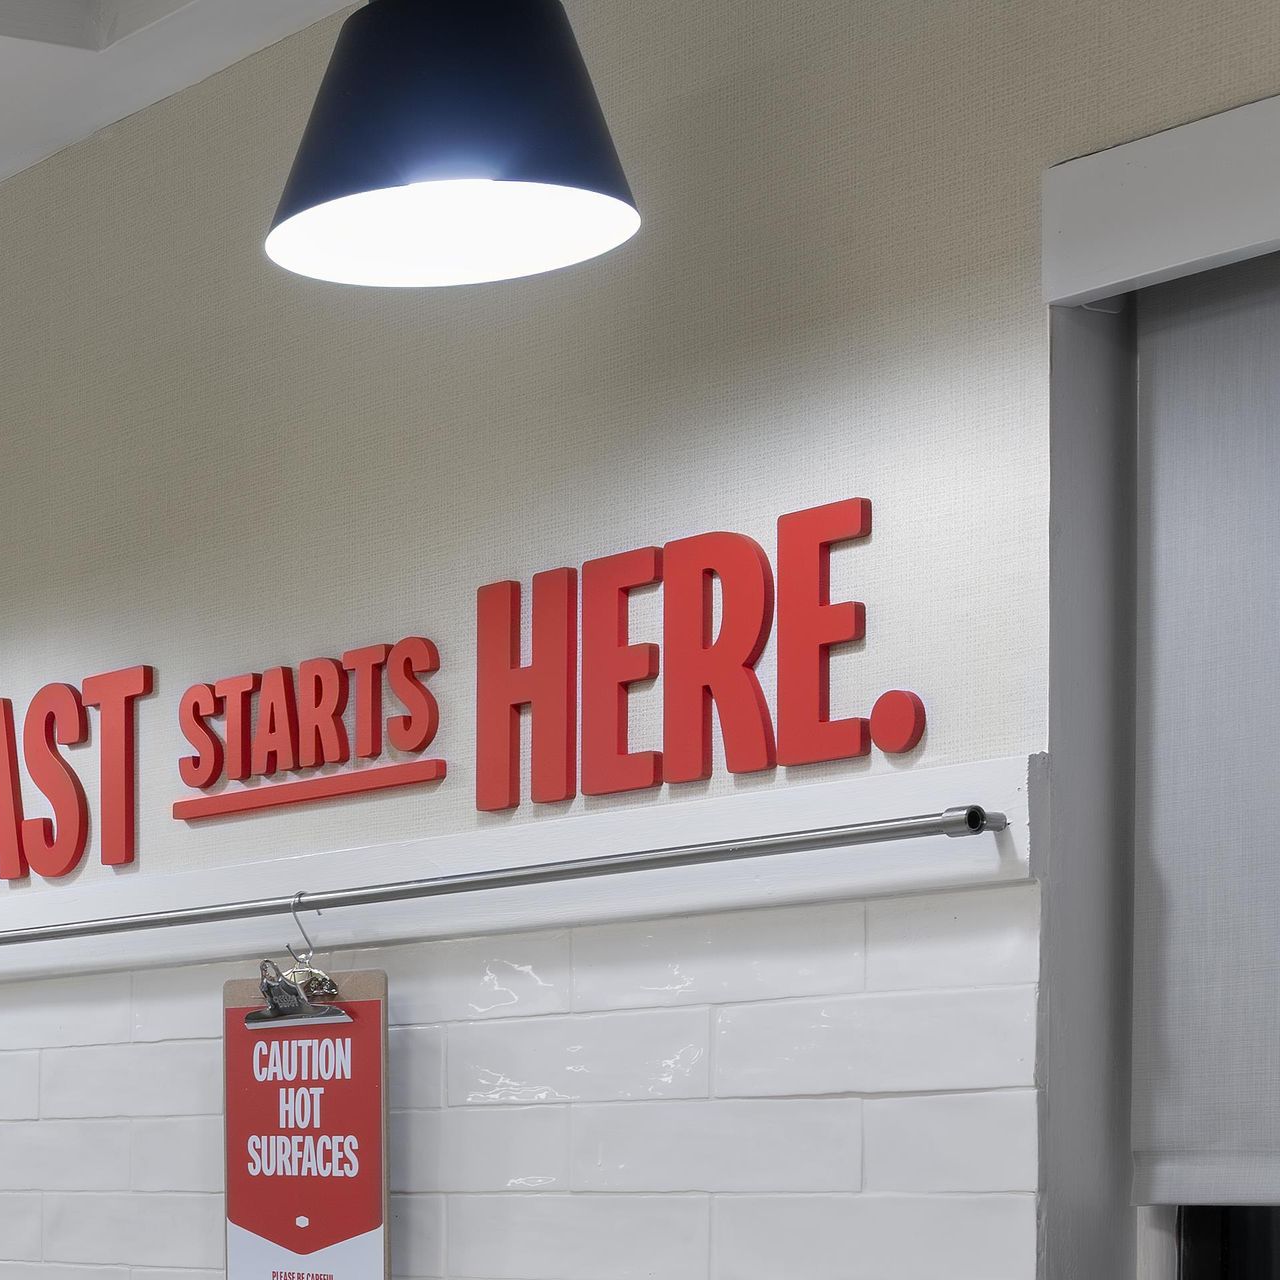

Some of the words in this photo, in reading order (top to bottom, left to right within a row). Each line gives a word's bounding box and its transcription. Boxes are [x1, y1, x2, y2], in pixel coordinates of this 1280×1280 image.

[178, 636, 440, 789] STARTS
[475, 497, 926, 812] HERE.
[252, 1038, 352, 1081] CAUTION
[279, 1087, 324, 1129] HOT
[247, 1135, 359, 1177] SURFACES
